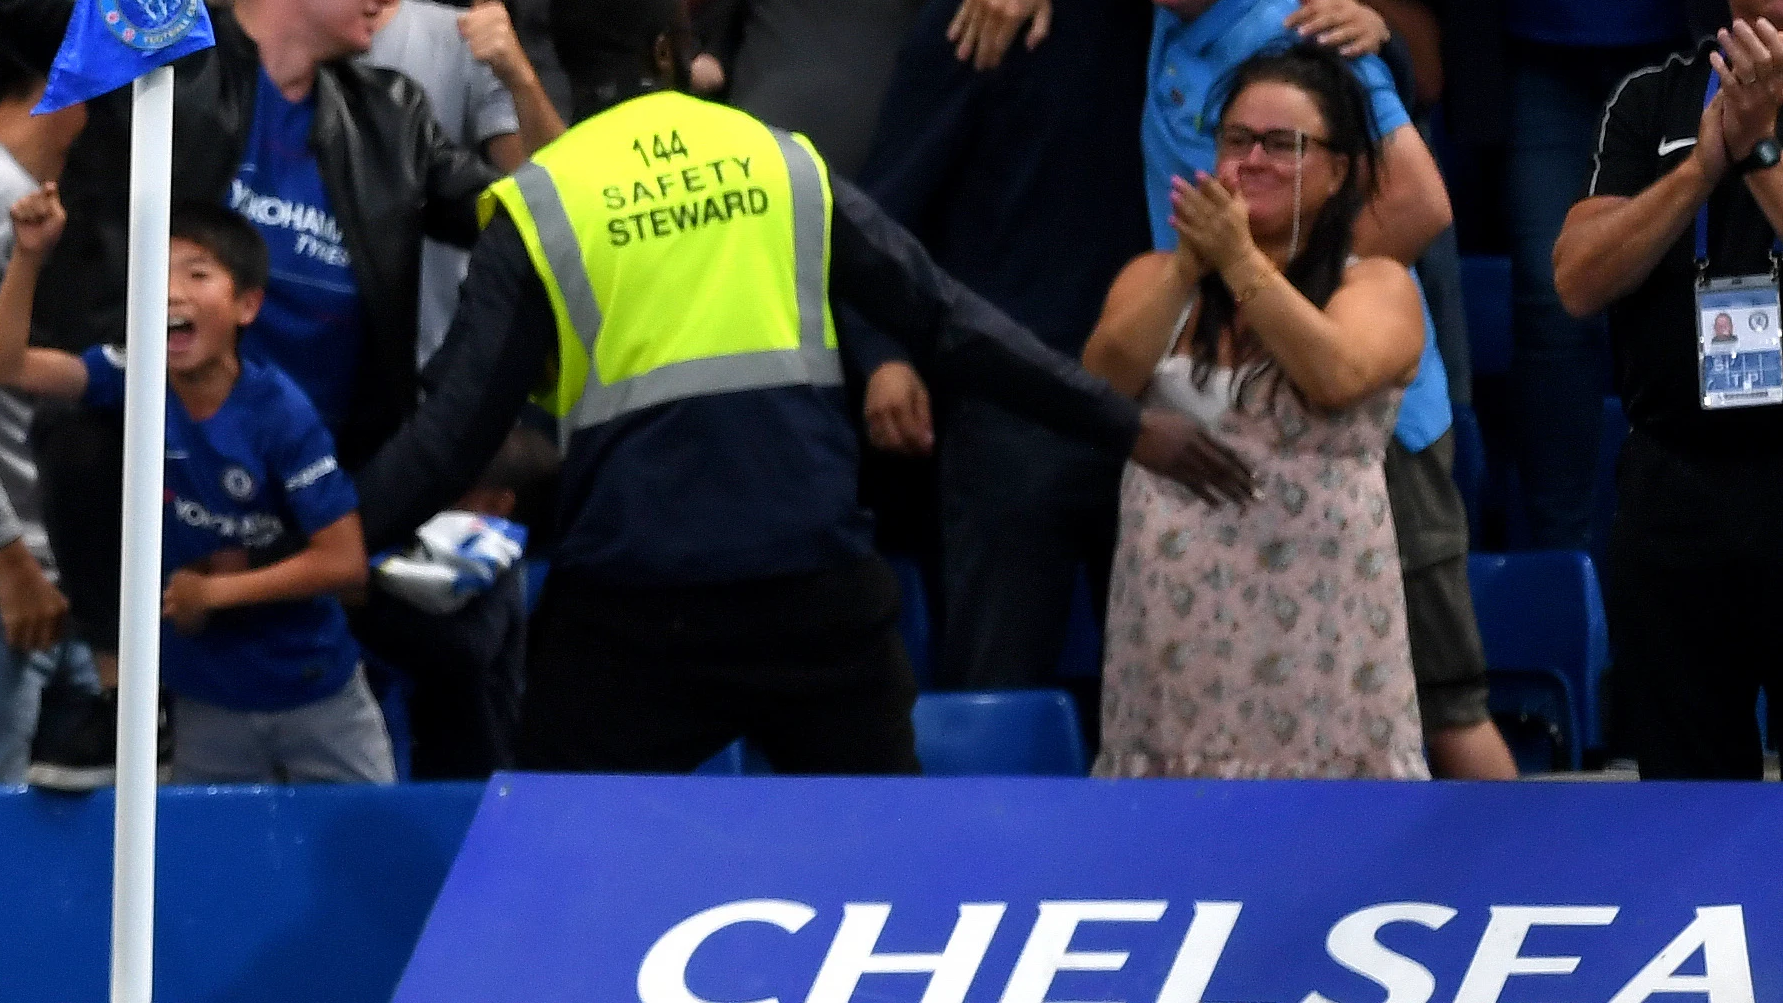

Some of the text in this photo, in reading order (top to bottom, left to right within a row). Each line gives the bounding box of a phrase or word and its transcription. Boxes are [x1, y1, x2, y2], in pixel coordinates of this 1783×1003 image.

[633, 130, 688, 168] 144
[603, 156, 751, 209] SAFETY
[607, 187, 769, 247] STEWARD
[637, 899, 1754, 1003] CHELSEA
